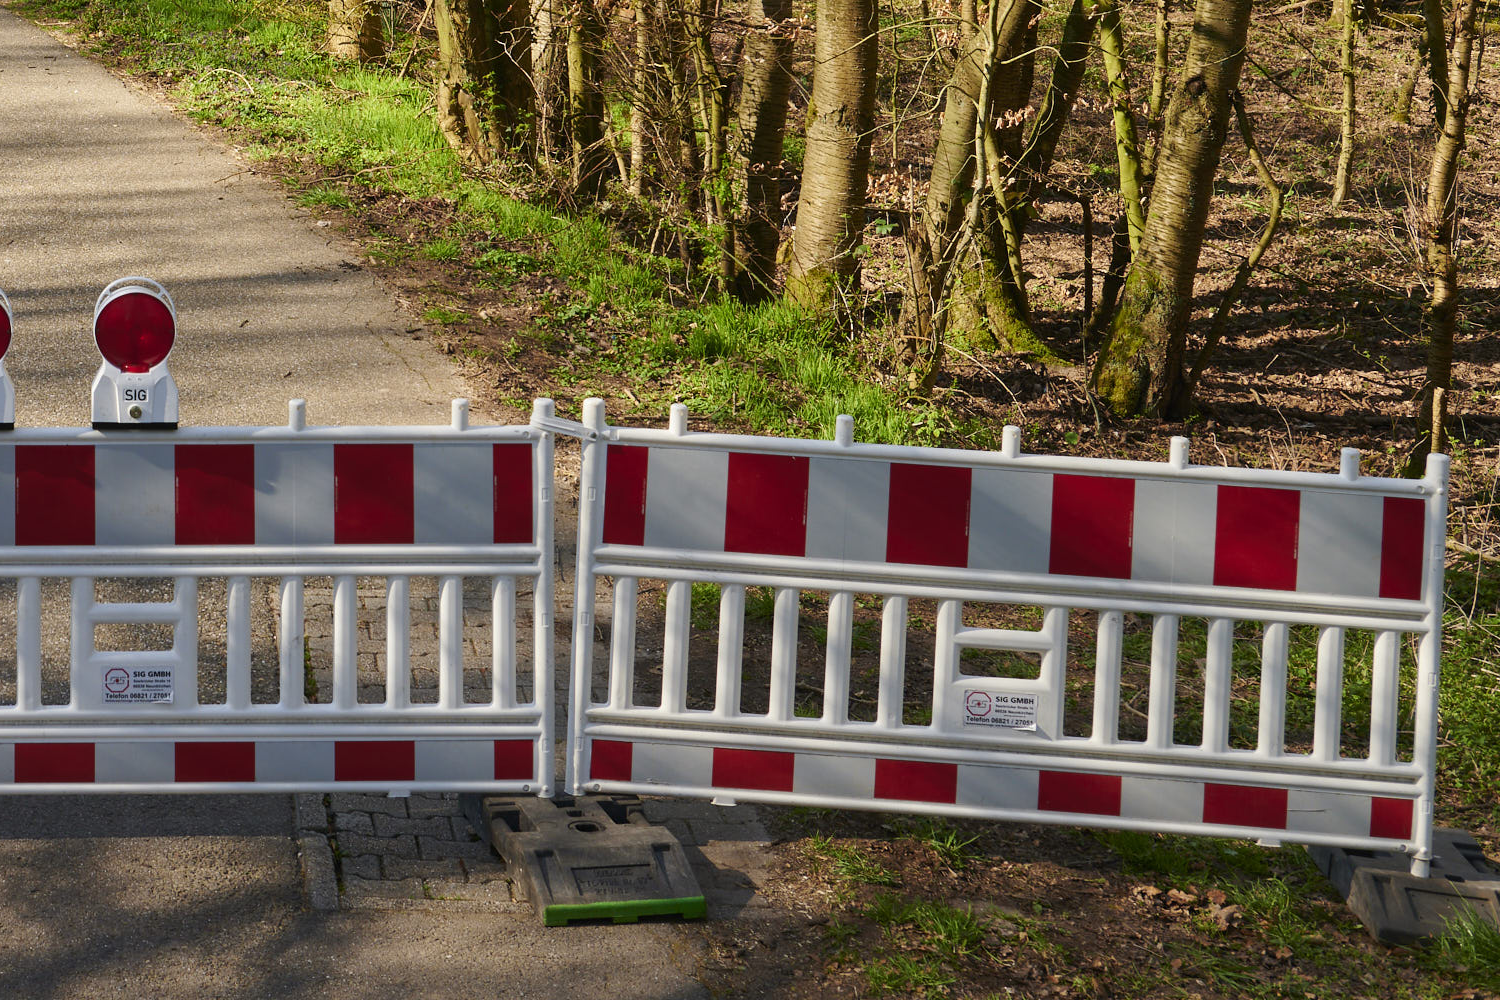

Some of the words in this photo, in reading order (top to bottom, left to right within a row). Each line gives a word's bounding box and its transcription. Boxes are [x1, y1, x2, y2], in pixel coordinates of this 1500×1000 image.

[125, 389, 147, 401] SIG
[1010, 697, 1035, 705] GMBH
[966, 715, 990, 723] Telefon
